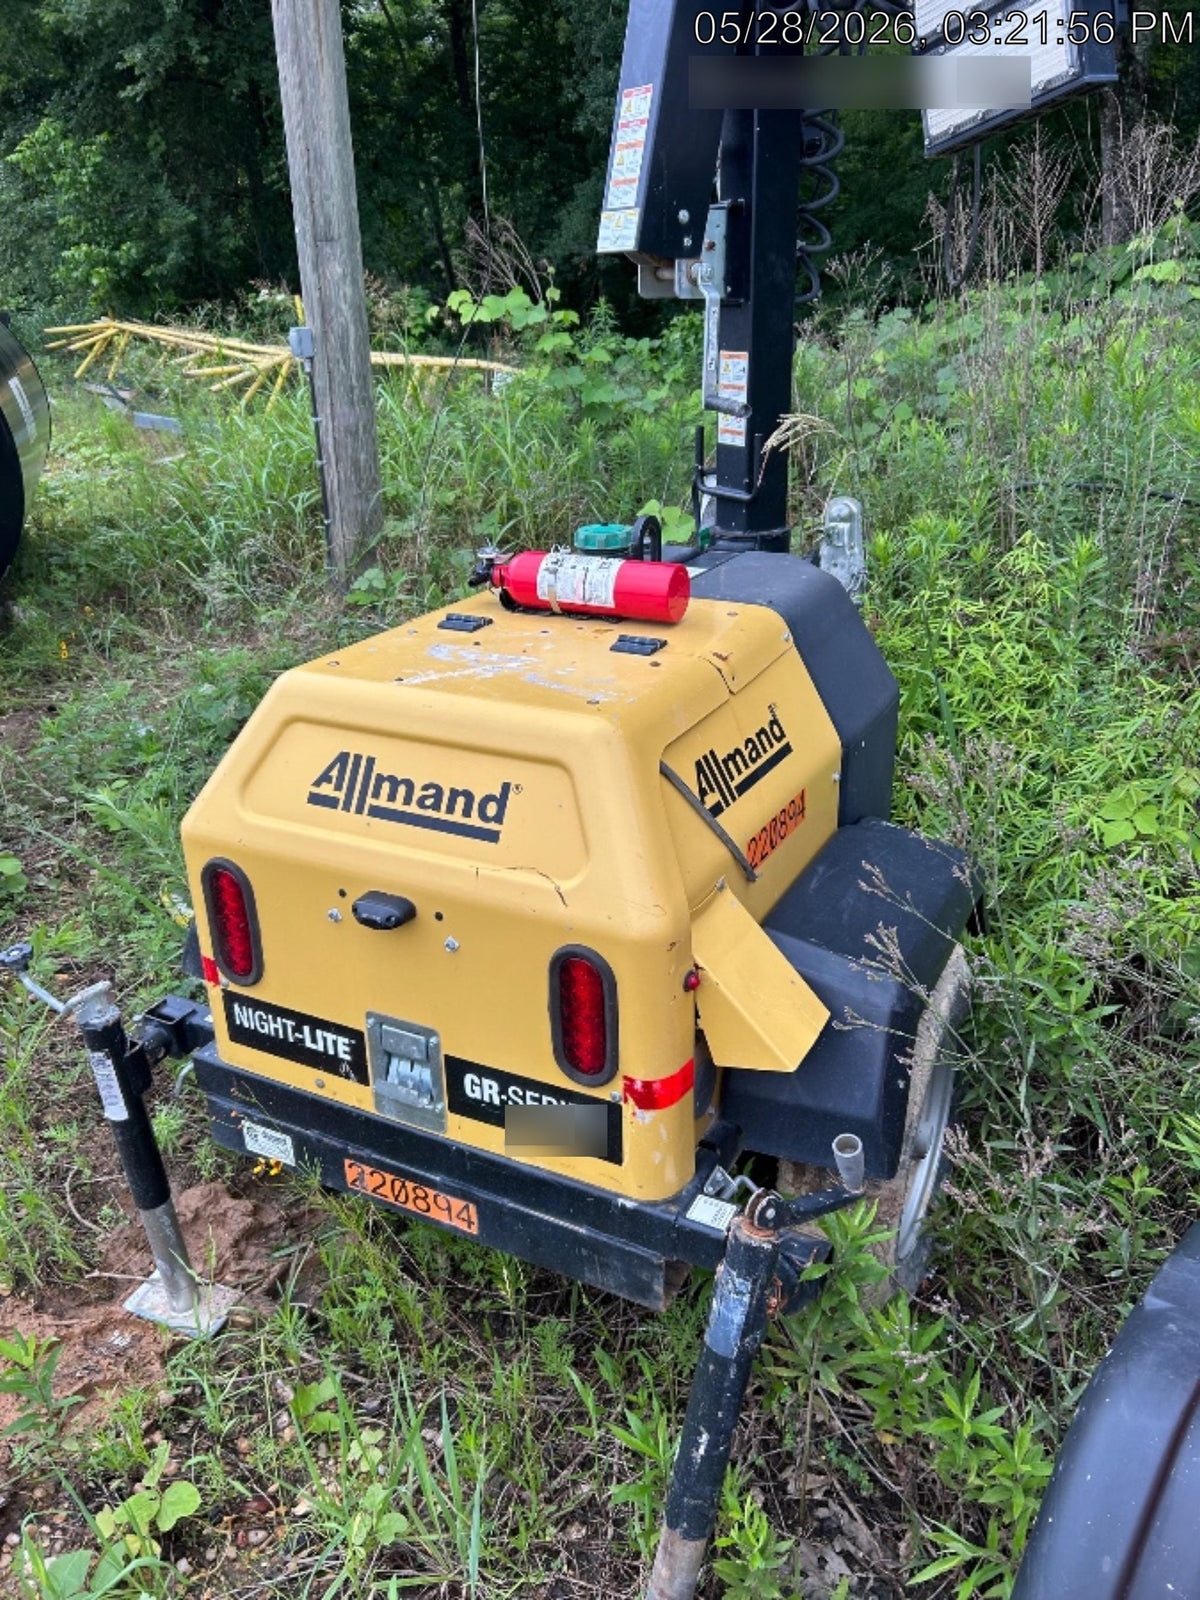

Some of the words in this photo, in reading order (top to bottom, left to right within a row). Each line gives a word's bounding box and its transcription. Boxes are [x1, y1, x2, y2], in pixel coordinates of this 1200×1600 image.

[309, 751, 512, 826] Allmand
[694, 714, 788, 809] Allmand
[748, 786, 807, 870] 220894
[233, 1002, 351, 1060] NIGHT-LITE
[347, 1161, 476, 1231] 220894
